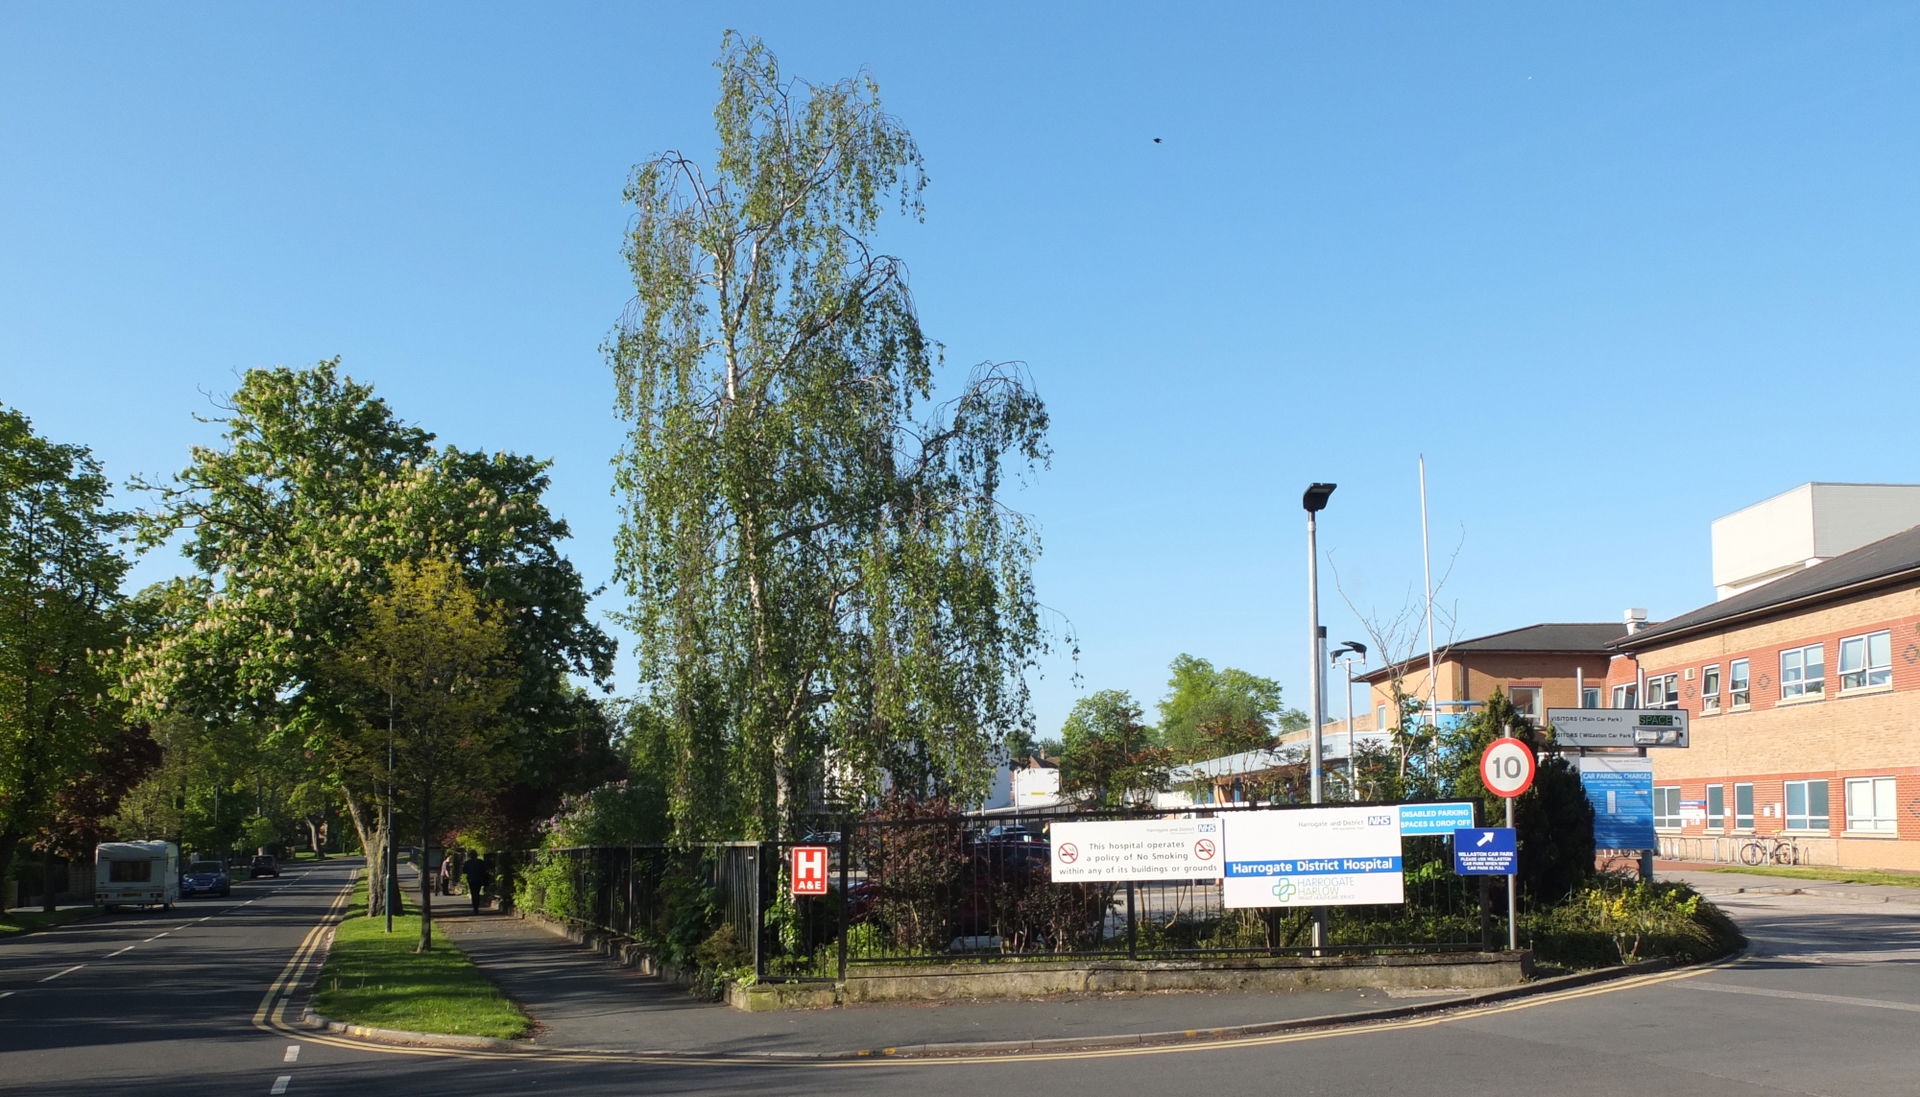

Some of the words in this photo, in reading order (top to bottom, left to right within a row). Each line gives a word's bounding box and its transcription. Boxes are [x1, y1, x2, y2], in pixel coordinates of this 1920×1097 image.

[1639, 715, 1673, 725] SPACE
[1492, 756, 1521, 779] 10
[1624, 772, 1651, 780] CHARGES
[1401, 810, 1437, 818] DISABLED
[1437, 809, 1469, 817] PARKING
[1198, 824, 1216, 832] NHS
[1298, 821, 1328, 829] Harrogate
[1368, 816, 1390, 825] NHS
[1400, 821, 1429, 829] SPACES
[1436, 820, 1456, 828] DROP
[1457, 819, 1472, 827] OFF
[1109, 841, 1144, 852] hospital
[1147, 841, 1185, 851] operates
[1095, 853, 1120, 863] policy
[1124, 853, 1133, 861] of
[1137, 853, 1149, 861] No
[1152, 852, 1188, 862] Smoking
[798, 851, 822, 879] H
[1059, 866, 1085, 875] within
[1088, 867, 1101, 876] any
[1105, 865, 1115, 874] of
[1117, 865, 1128, 873] its
[1131, 864, 1168, 875] buildings
[1184, 863, 1217, 874] grounds
[1232, 861, 1293, 875] Harrogate
[1297, 859, 1340, 872] District
[1343, 857, 1393, 873] Hospital
[798, 880, 822, 890] A&E
[1298, 876, 1355, 888] HARROGATE
[1298, 886, 1340, 896] HARLOW
